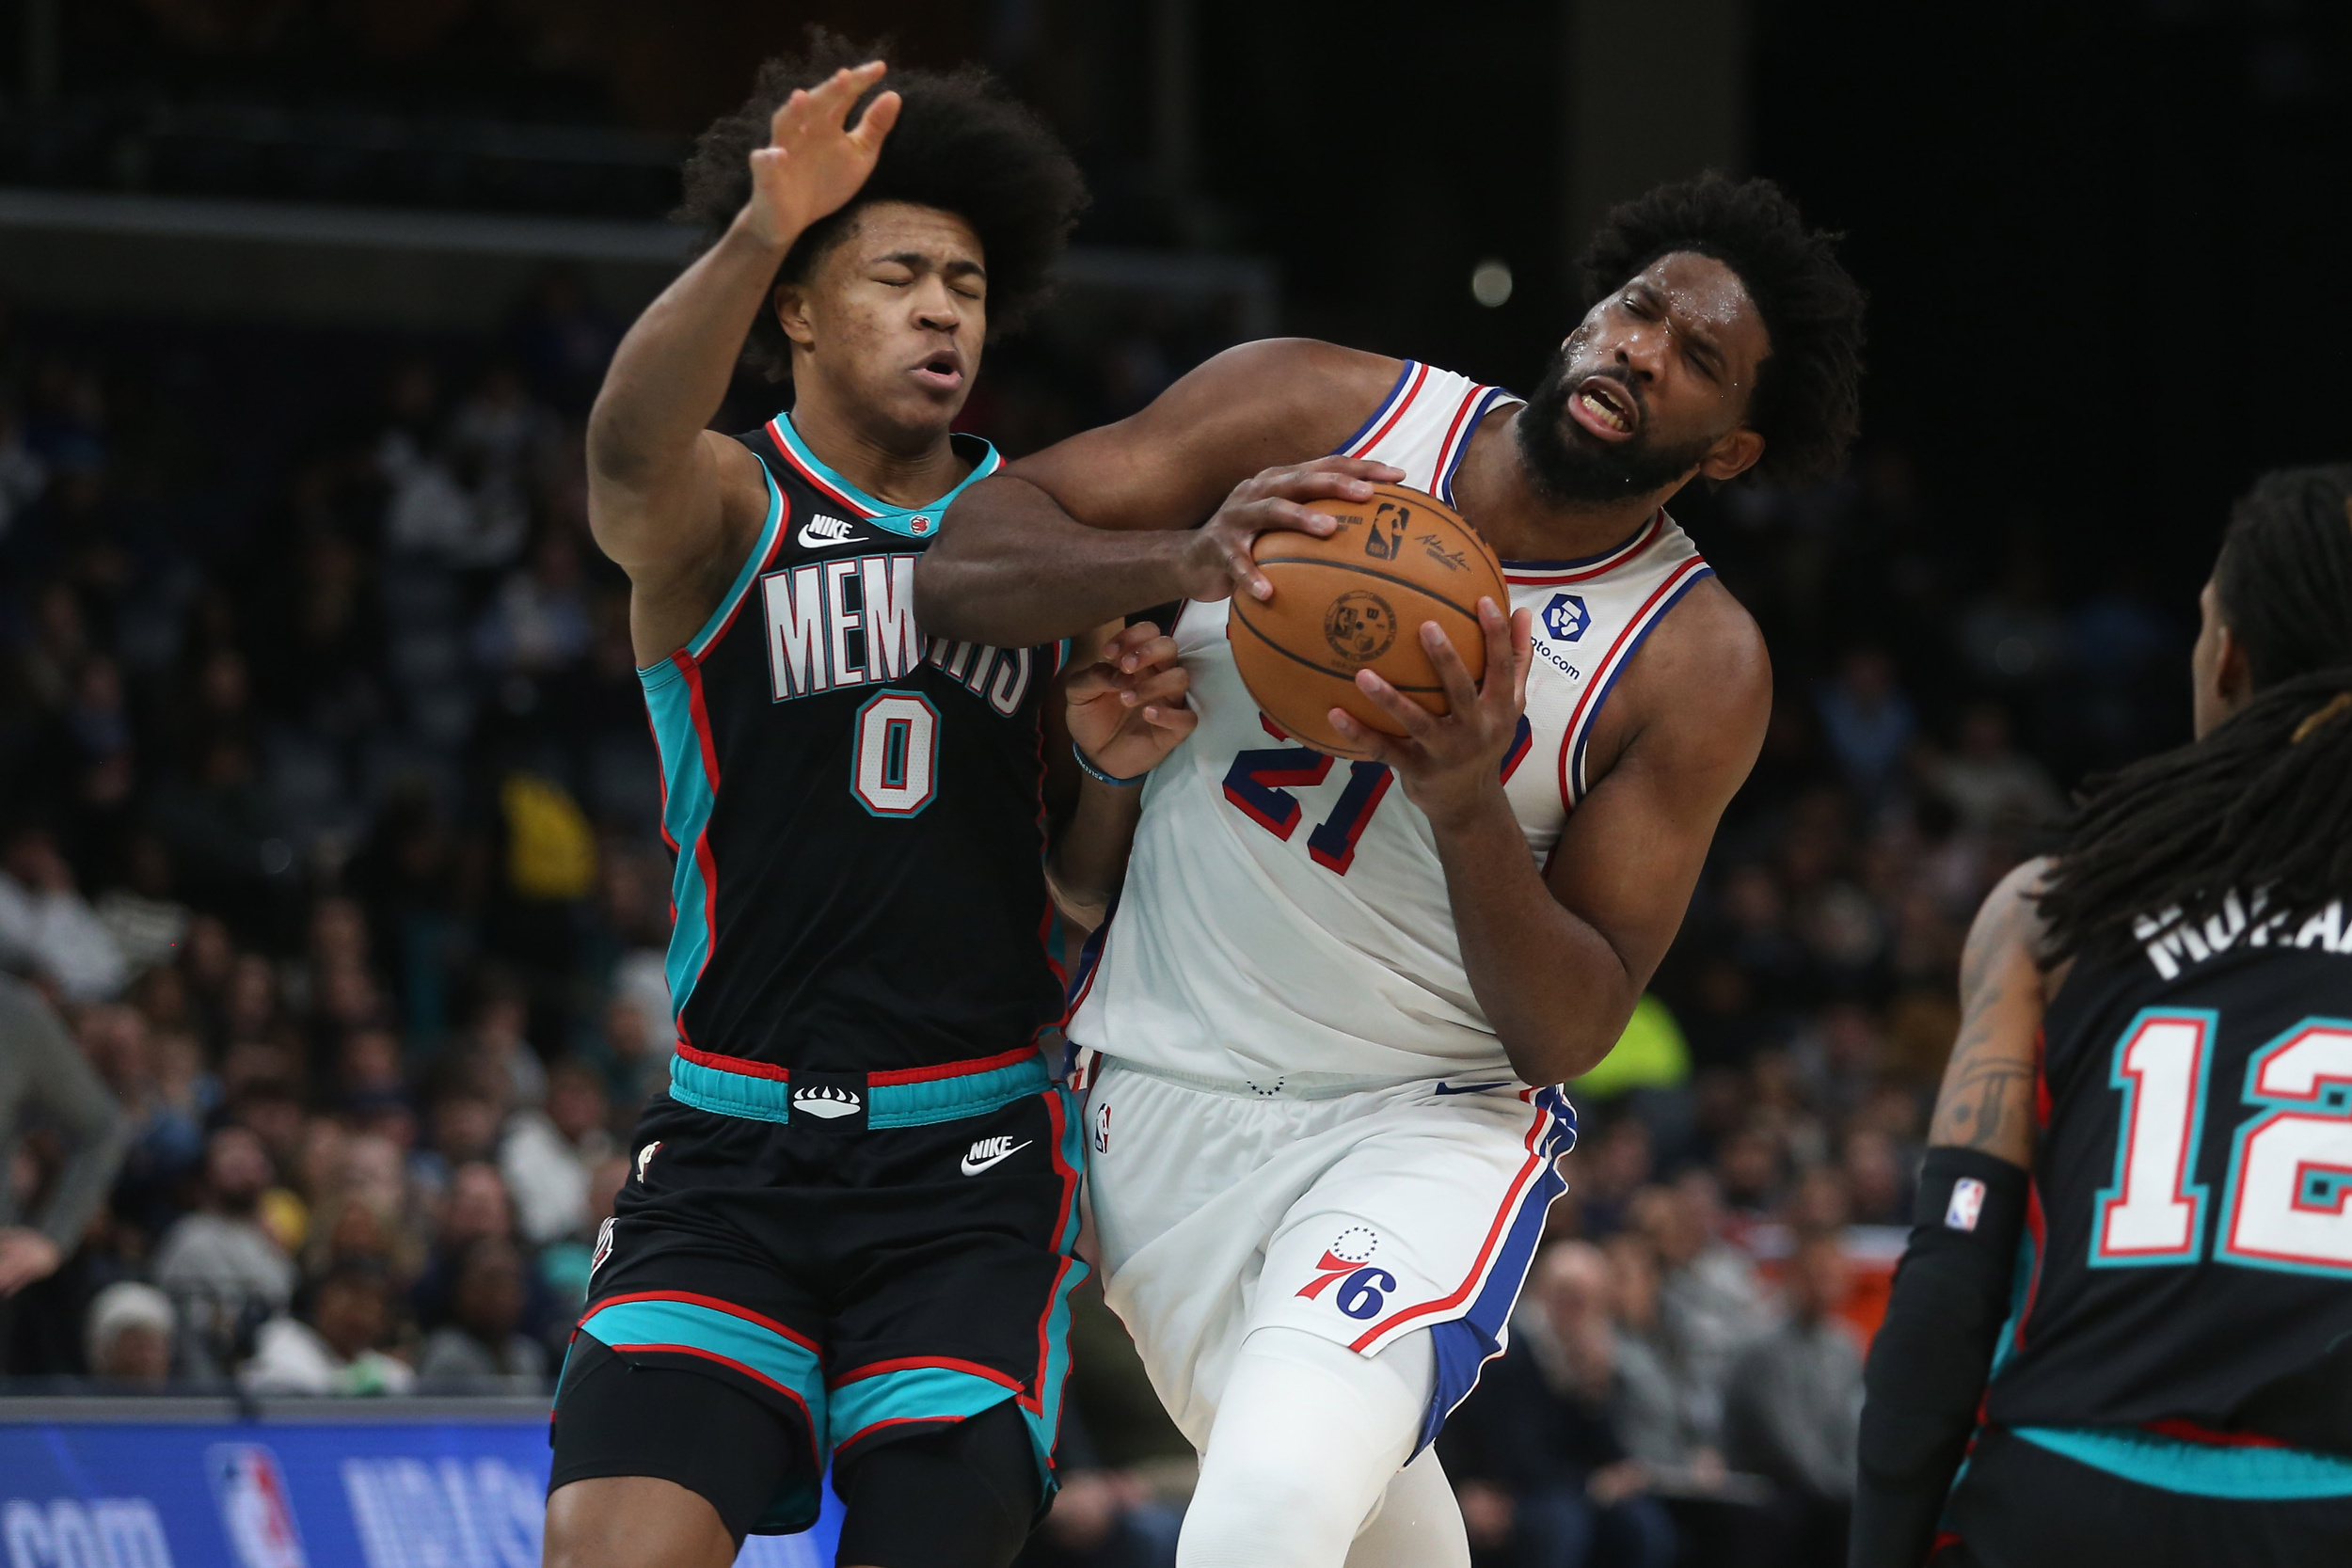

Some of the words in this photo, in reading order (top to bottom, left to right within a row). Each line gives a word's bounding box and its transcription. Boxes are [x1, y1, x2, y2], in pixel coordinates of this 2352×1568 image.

[808, 514, 853, 539] NIKE
[850, 689, 941, 818] 0
[1222, 743, 1394, 877] 21
[968, 1135, 1013, 1162] NIKE
[2087, 1006, 2352, 1278] 12
[1294, 1248, 1397, 1321] 76
